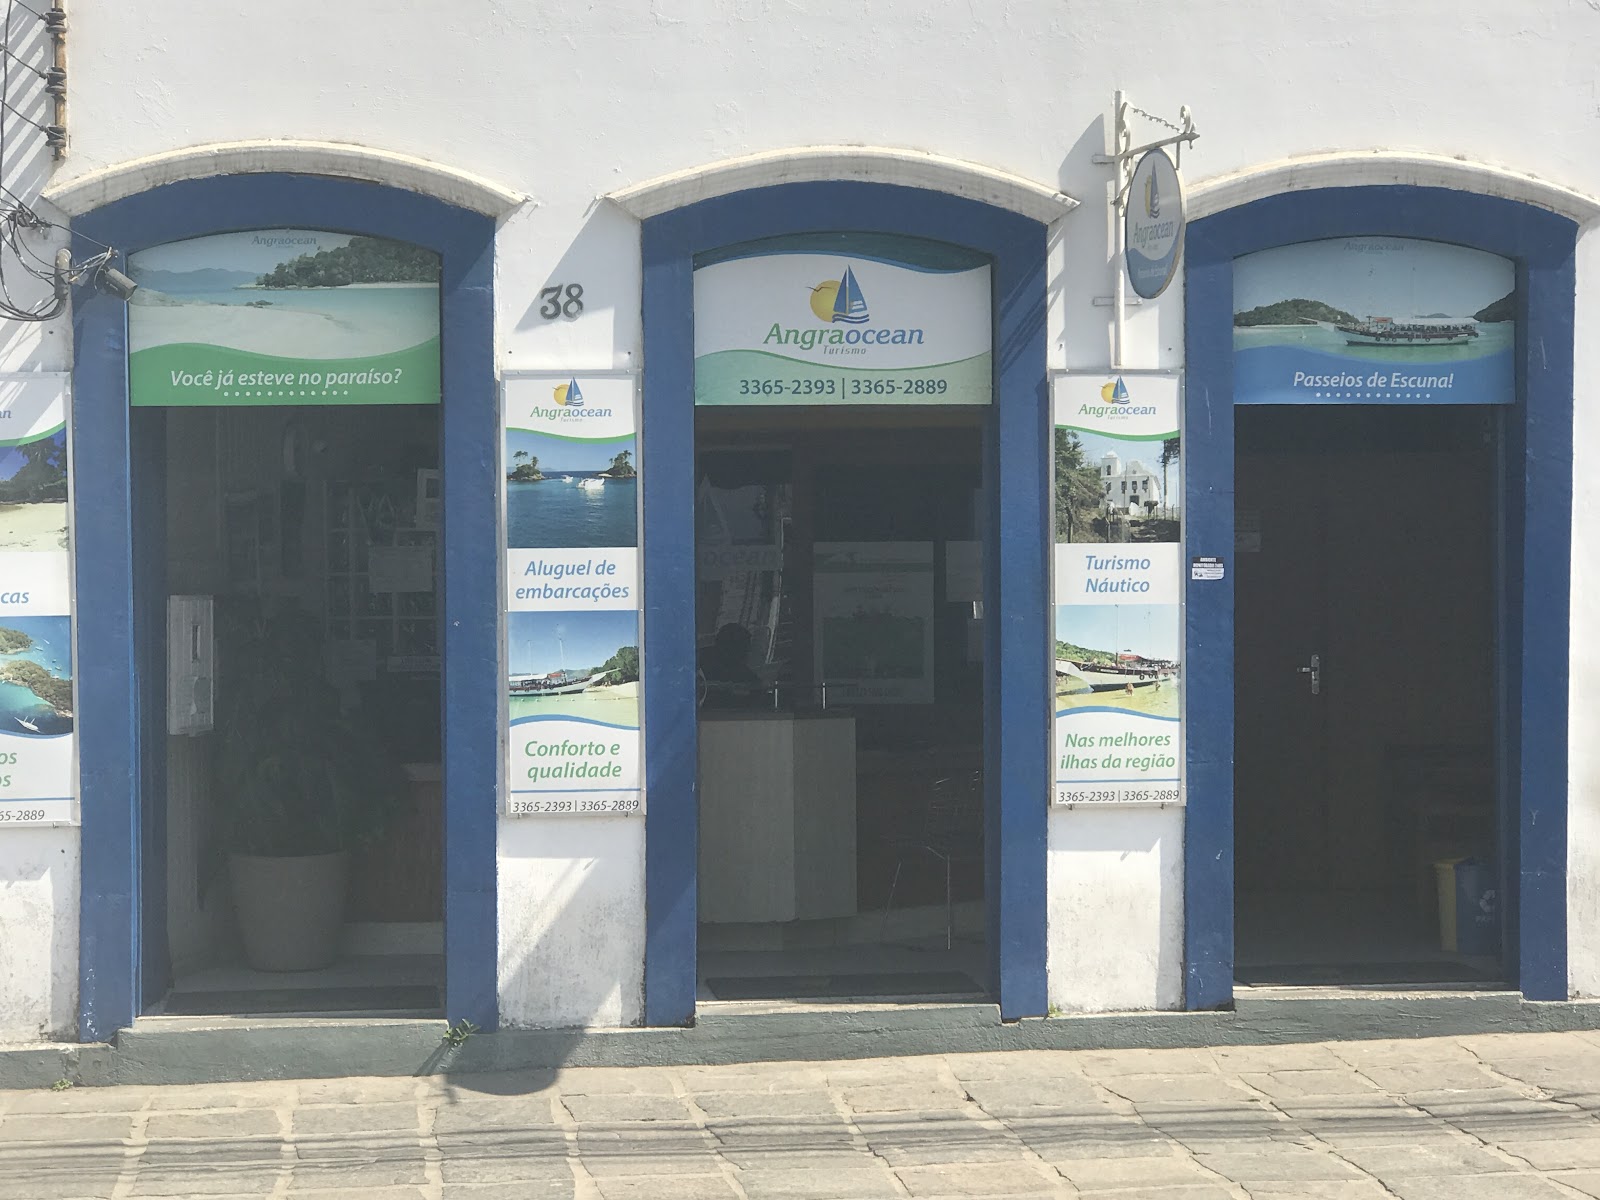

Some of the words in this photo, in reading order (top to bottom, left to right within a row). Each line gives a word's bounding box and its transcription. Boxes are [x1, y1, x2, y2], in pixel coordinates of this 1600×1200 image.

[251, 236, 317, 247] Angraocean
[1133, 221, 1174, 248] Angraocean
[540, 283, 584, 320] 38
[763, 323, 924, 350] Angraocean
[823, 345, 866, 355] Turismo
[170, 368, 213, 386] Você
[214, 368, 234, 390] já
[238, 371, 294, 386] esteve
[298, 371, 321, 386] no
[325, 368, 402, 389] paraíso?
[740, 379, 836, 395] 3365-2393
[851, 379, 947, 394] 3365-2889
[1293, 371, 1363, 388] Passeios
[1366, 371, 1387, 388] de
[1390, 372, 1454, 389] Escuna!
[530, 406, 612, 420] Angraocean
[1078, 404, 1156, 418] Angraocean
[524, 560, 591, 579] Aluguel
[594, 560, 616, 575] de
[1085, 555, 1150, 570] Turismo
[515, 583, 629, 602] embarcações
[1085, 578, 1150, 593] Náutico
[1065, 733, 1095, 748] Nas
[1099, 732, 1171, 747] melhores
[524, 740, 606, 757] Conforto
[609, 743, 621, 756] e
[1060, 754, 1098, 769] ilhas
[1101, 754, 1122, 769] da
[1125, 754, 1175, 771] região
[527, 761, 622, 782] qualidade
[1058, 791, 1115, 802] 3365-2393
[1122, 790, 1179, 801] 3365-2889
[513, 801, 572, 812] 3365-2393
[580, 800, 639, 812] 3365-2889
